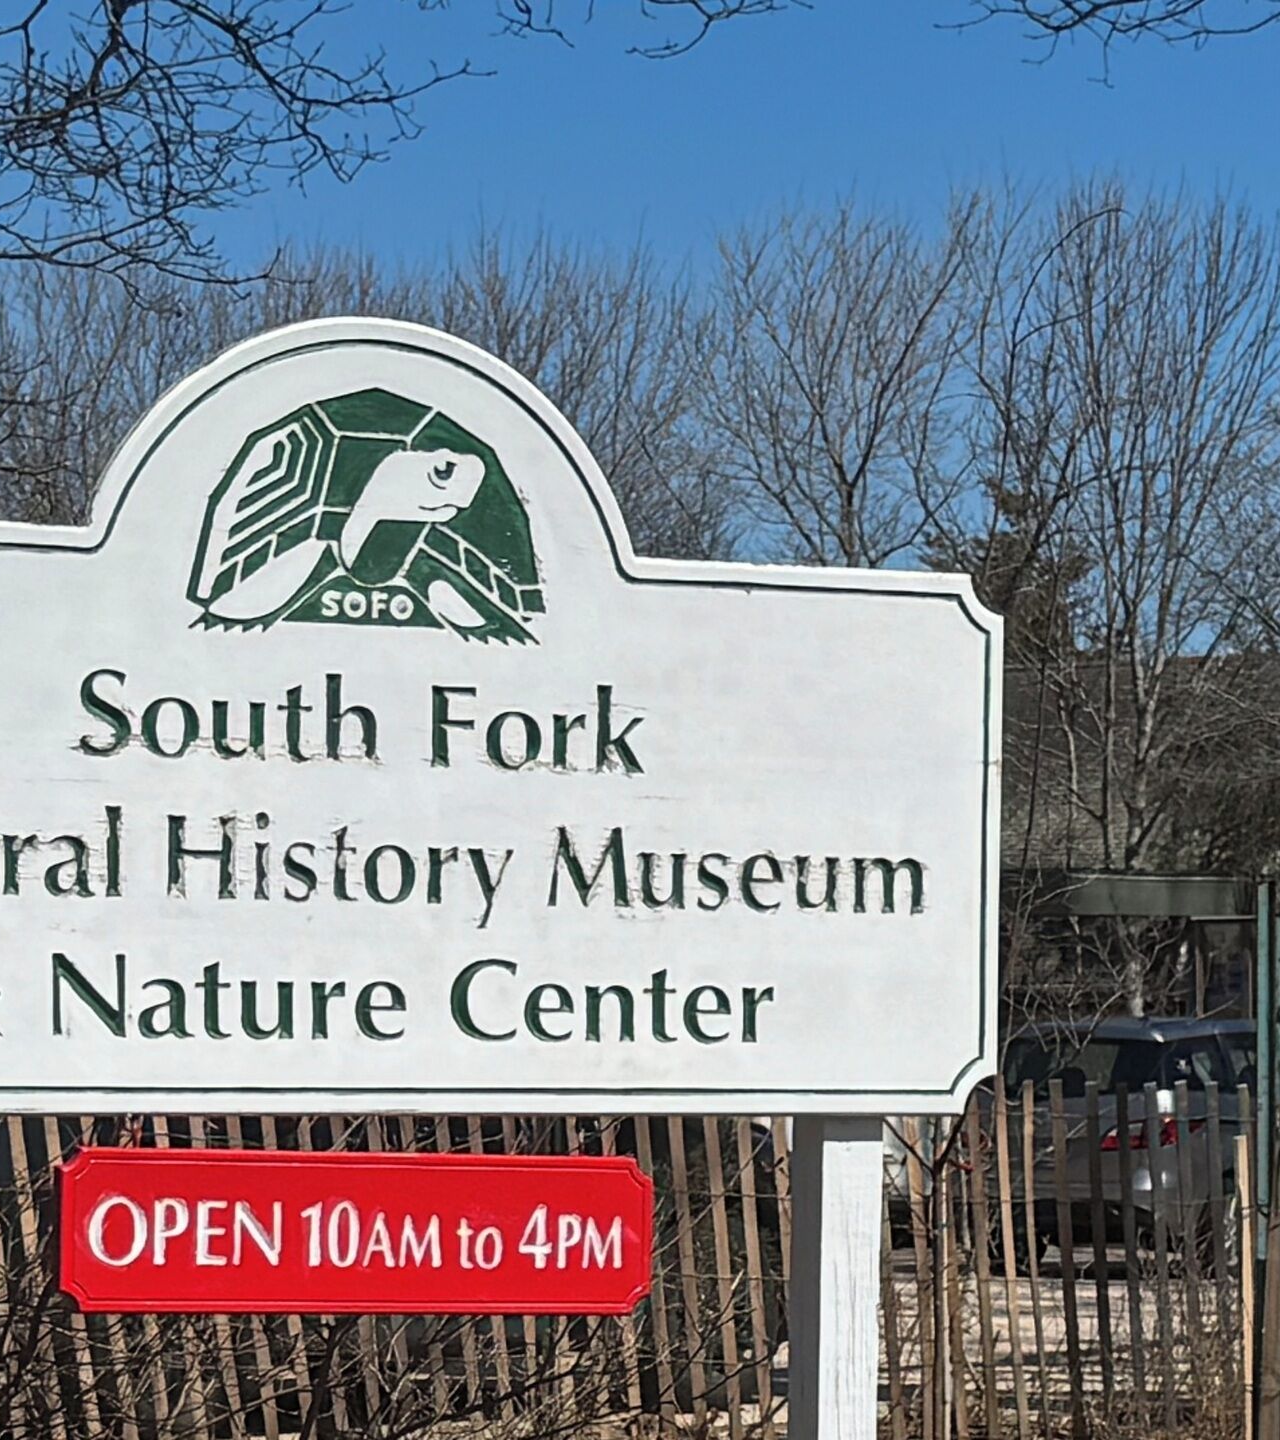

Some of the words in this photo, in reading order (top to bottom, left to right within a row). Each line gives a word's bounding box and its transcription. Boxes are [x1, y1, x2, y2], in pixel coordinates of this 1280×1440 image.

[320, 590, 414, 620] SOFO
[70, 668, 378, 763] South
[430, 684, 645, 776] Fork
[166, 811, 513, 930] History
[548, 825, 925, 916] Museum
[51, 952, 407, 1042] Nature
[449, 958, 775, 1045] Center
[87, 1195, 283, 1268] OPEN
[300, 1199, 443, 1269] 10AM
[456, 1216, 503, 1270] to
[518, 1203, 623, 1270] 4PM
